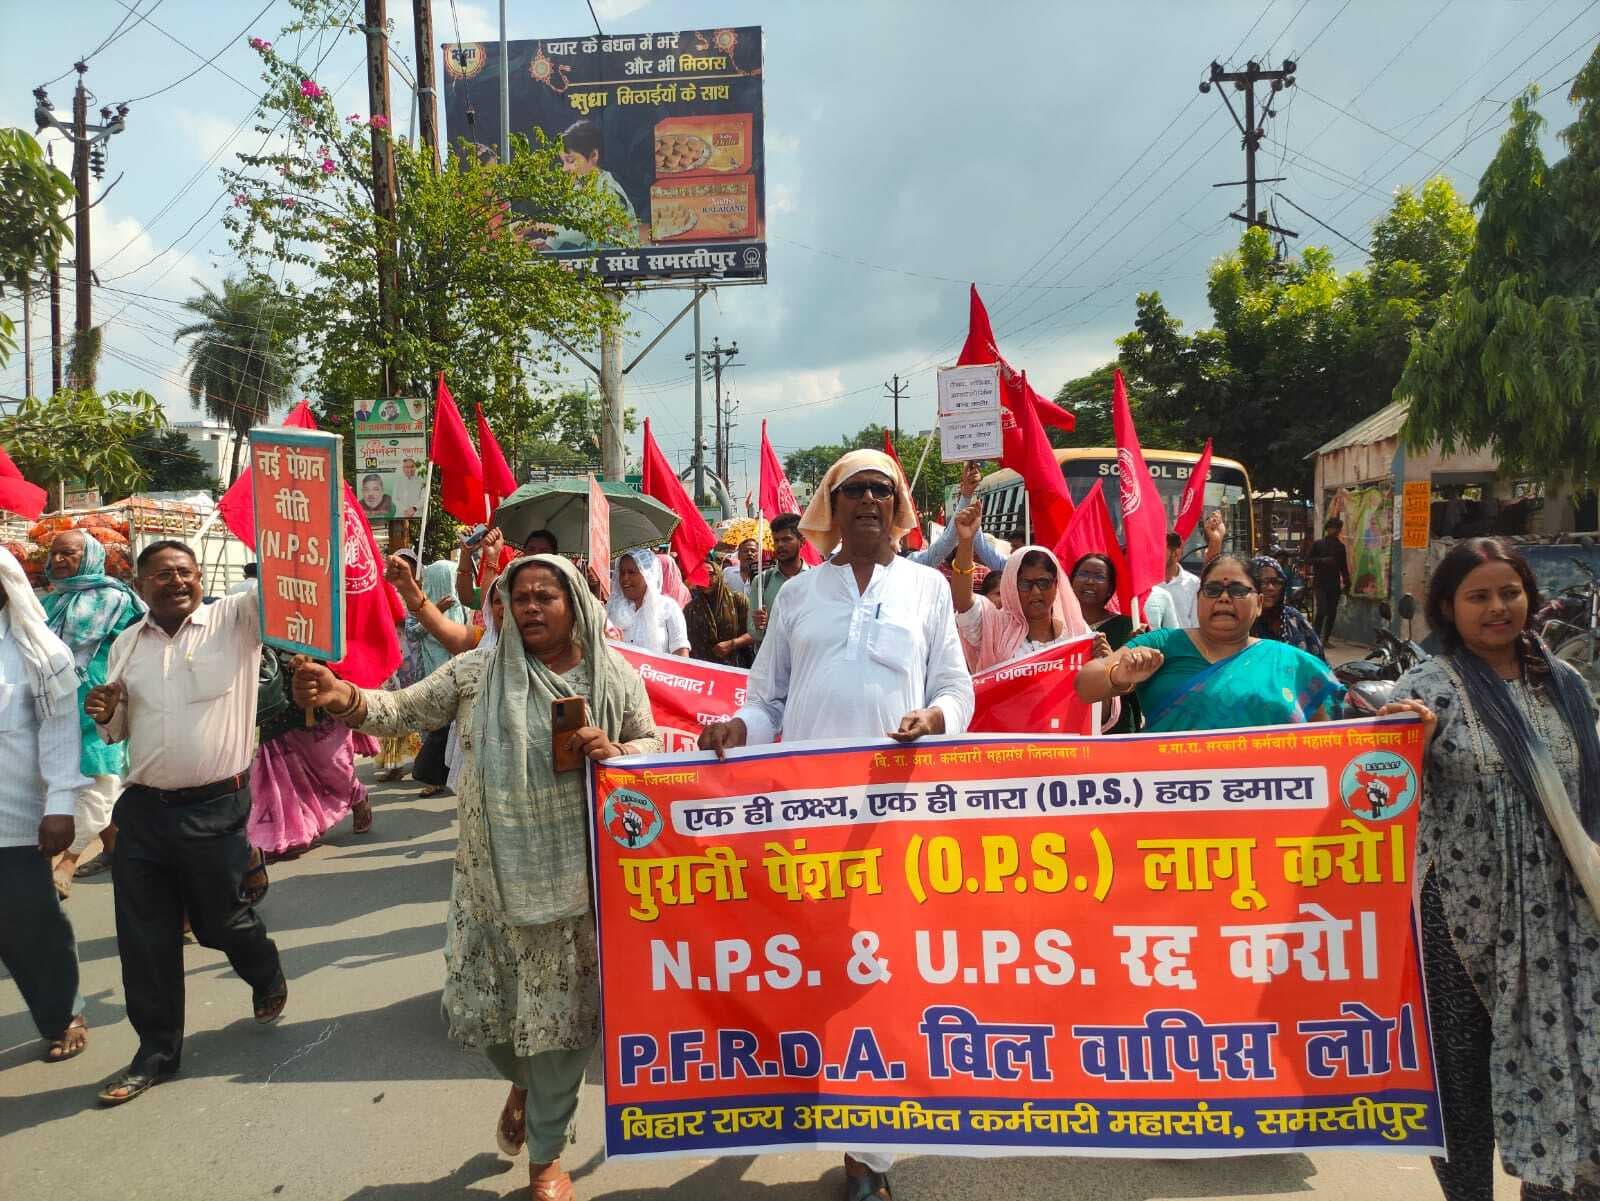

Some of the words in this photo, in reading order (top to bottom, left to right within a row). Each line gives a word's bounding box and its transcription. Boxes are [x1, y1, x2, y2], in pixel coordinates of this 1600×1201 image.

[547, 41, 578, 55] प्यार
[582, 37, 599, 54] के
[625, 55, 653, 75] और
[657, 55, 675, 73] भी
[679, 53, 728, 72] मिठास
[568, 91, 608, 115] सुधा
[679, 82, 697, 102] के
[700, 84, 730, 101] साथ
[605, 252, 640, 272] संघ
[646, 249, 737, 272] समस्तीपुर
[257, 446, 281, 480] नई
[286, 447, 325, 481] पेंशन
[1098, 463, 1172, 478] SCOL
[274, 488, 310, 523] नीति
[259, 529, 331, 575] (N.P.S.)
[277, 575, 318, 606] वापस
[683, 805, 735, 832] एक
[743, 795, 773, 825] ही
[781, 795, 858, 822] लक्ष्य,
[867, 790, 917, 817] एक
[925, 784, 957, 815] ही
[965, 787, 1027, 813] नारा
[1036, 777, 1143, 813] (O.P.S.)
[1154, 780, 1212, 805] हक
[1221, 776, 1314, 803] हमारा
[618, 846, 748, 922] पुरानी
[762, 838, 883, 904] पेंशन
[904, 828, 1114, 905] (O.P.S.)
[1136, 837, 1269, 911] लागू
[650, 933, 822, 993] N.P.S.
[846, 931, 892, 984] &
[915, 928, 1096, 986] U.P.S.
[1113, 925, 1199, 990] रद्द
[619, 1027, 906, 1087] P.F.R.D.A.
[919, 1005, 1055, 1081] बिल
[1072, 1008, 1279, 1082] वापिस
[621, 1107, 706, 1141] बिहार
[711, 1106, 785, 1133] राज्य
[794, 1101, 962, 1132] अराजपत्रित
[969, 1102, 1100, 1133] कर्मचारी
[1108, 1101, 1245, 1139] महासंघ,
[1255, 1097, 1429, 1141] समस्तीपुर
